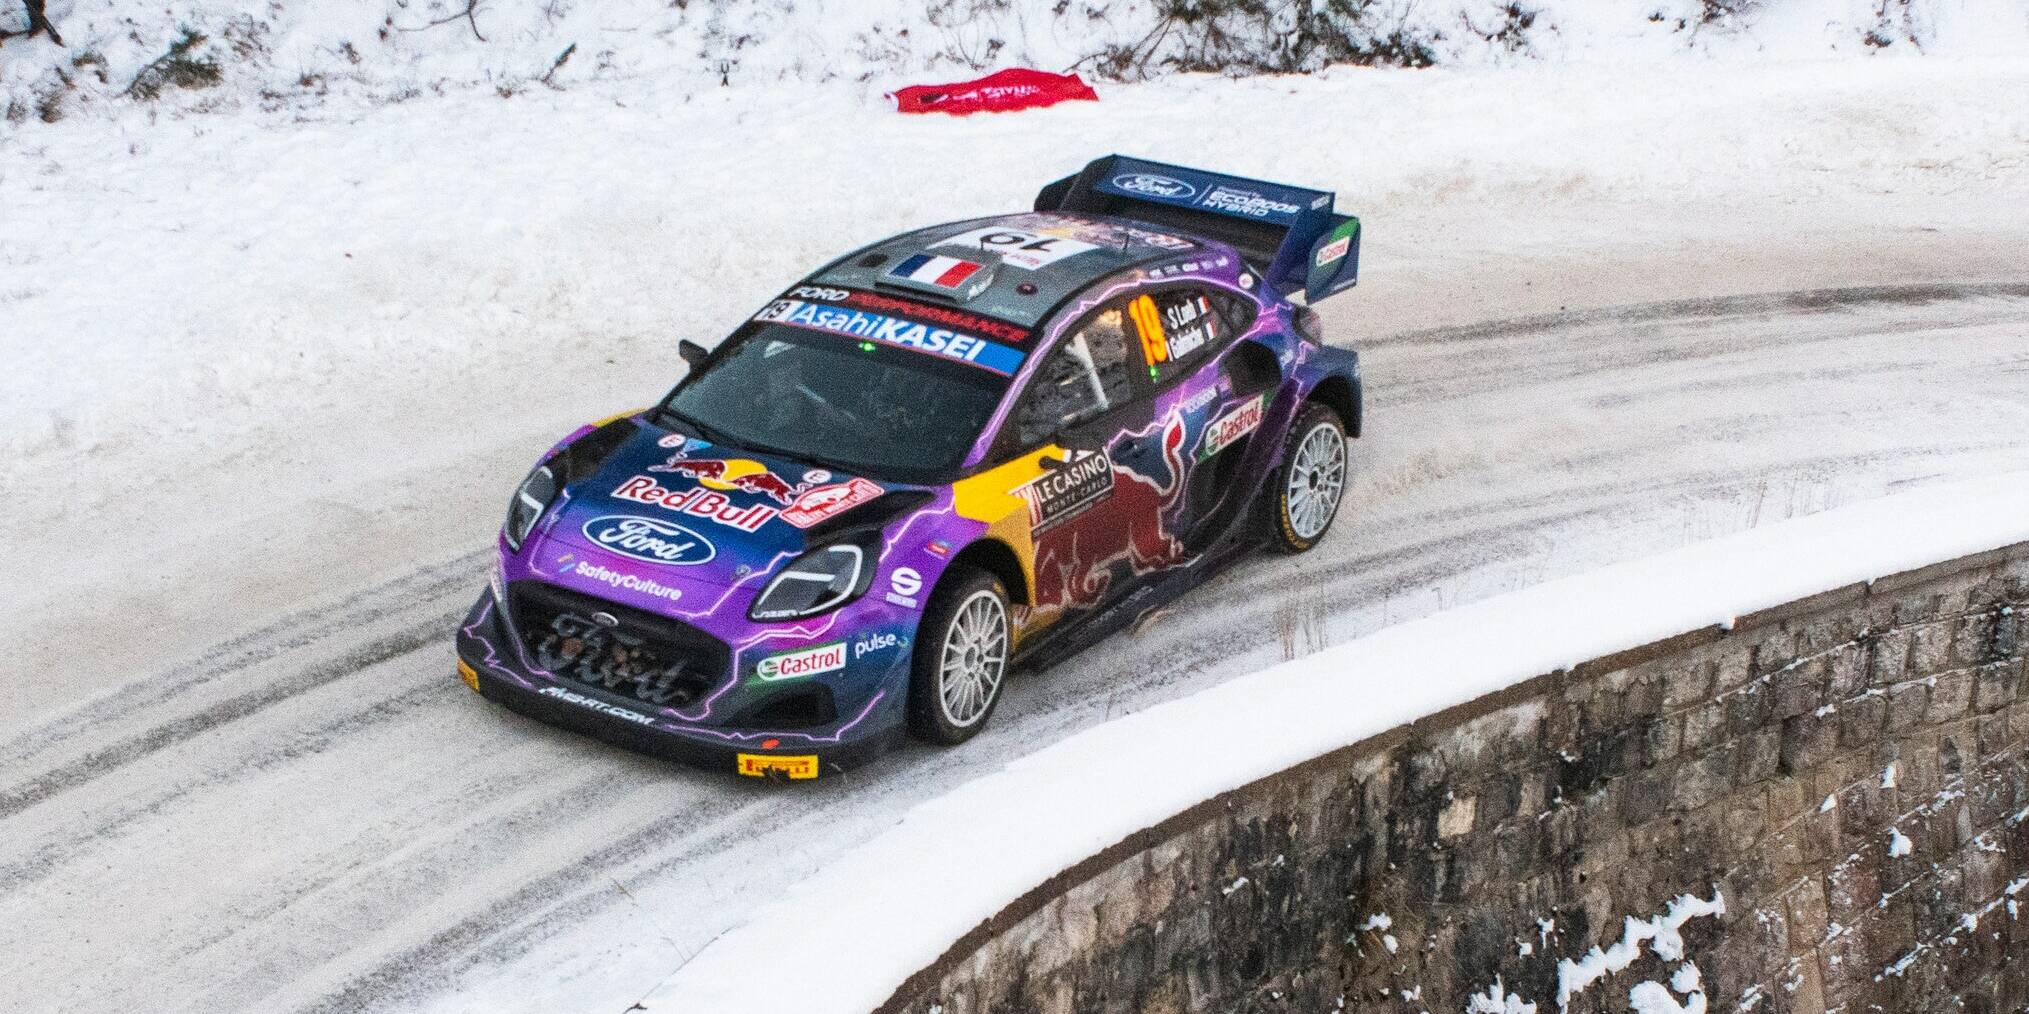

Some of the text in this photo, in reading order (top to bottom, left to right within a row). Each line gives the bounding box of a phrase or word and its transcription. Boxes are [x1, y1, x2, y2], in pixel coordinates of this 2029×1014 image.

[1123, 175, 1182, 197] Ford
[1202, 199, 1269, 217] HYBRID
[788, 286, 850, 301] FORD
[849, 290, 1031, 342] PERFORMANCE
[1128, 294, 1168, 367] 19
[1166, 307, 1179, 331] S
[1214, 407, 1260, 445] Castrol
[1036, 454, 1107, 504] LE CASINO
[690, 487, 777, 532] Bull
[597, 519, 698, 563] Ford
[574, 559, 684, 602] SafetyCulture
[778, 648, 844, 679] Castrol
[854, 633, 897, 659] pulse
